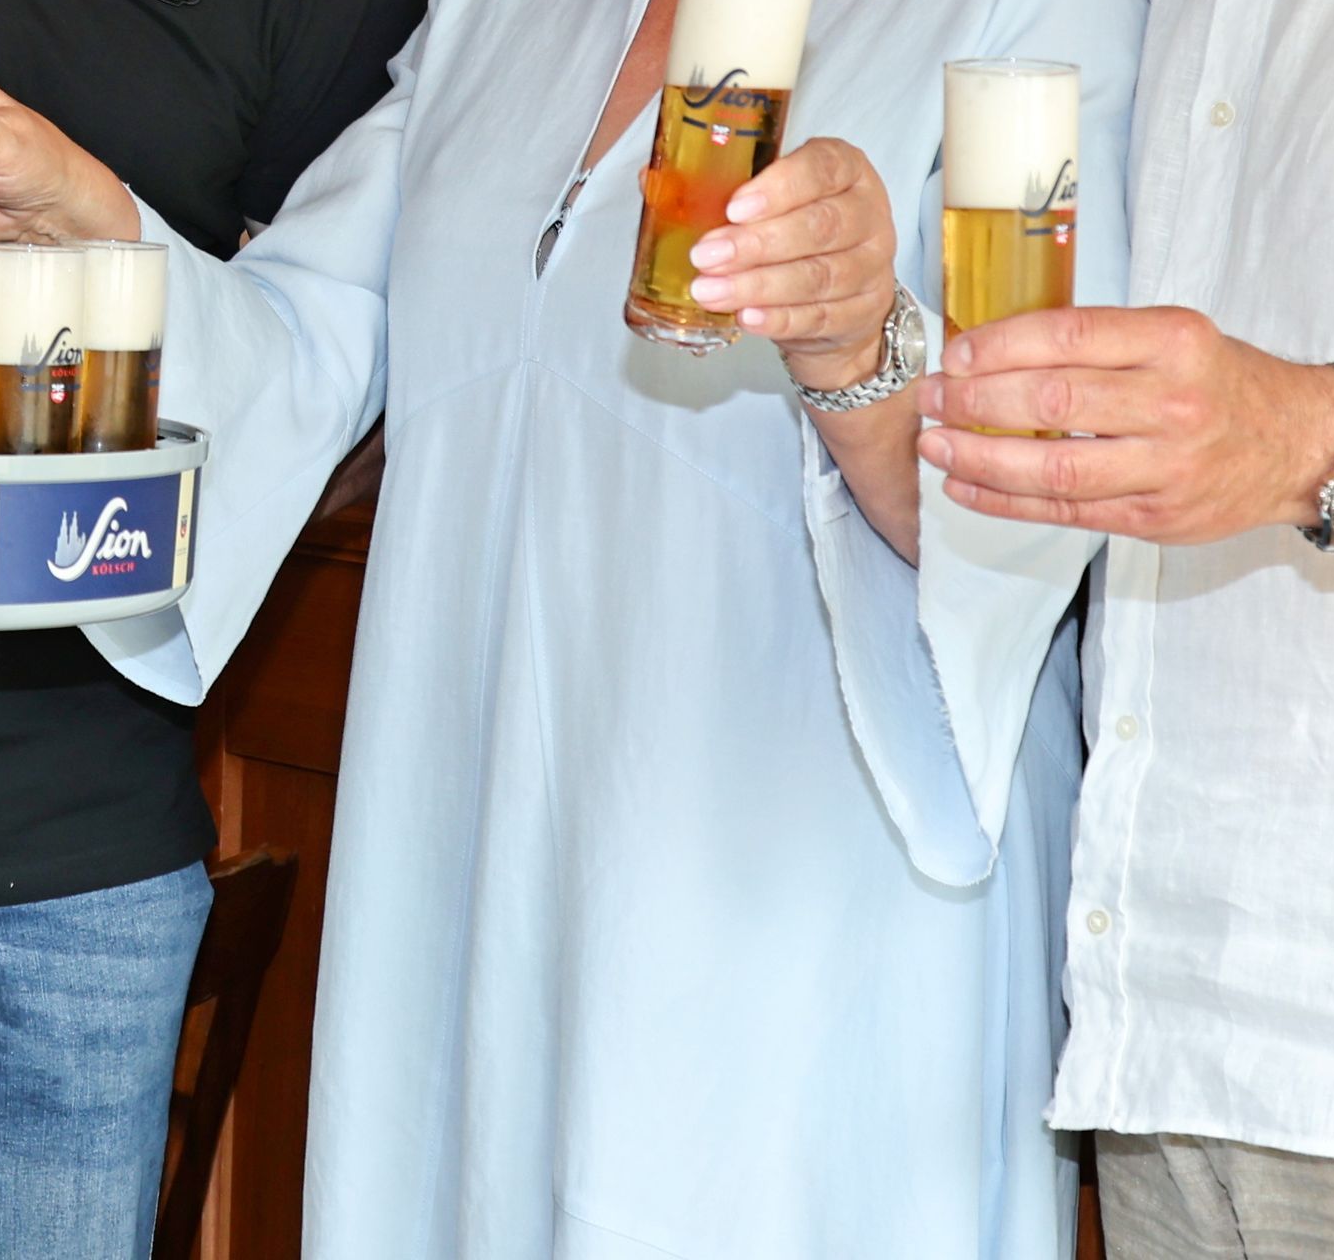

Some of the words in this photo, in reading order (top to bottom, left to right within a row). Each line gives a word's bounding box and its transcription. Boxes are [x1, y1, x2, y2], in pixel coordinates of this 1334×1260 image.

[1019, 159, 1078, 217] Sio
[47, 496, 152, 582] Sion
[91, 560, 136, 576] KÖLSCH
